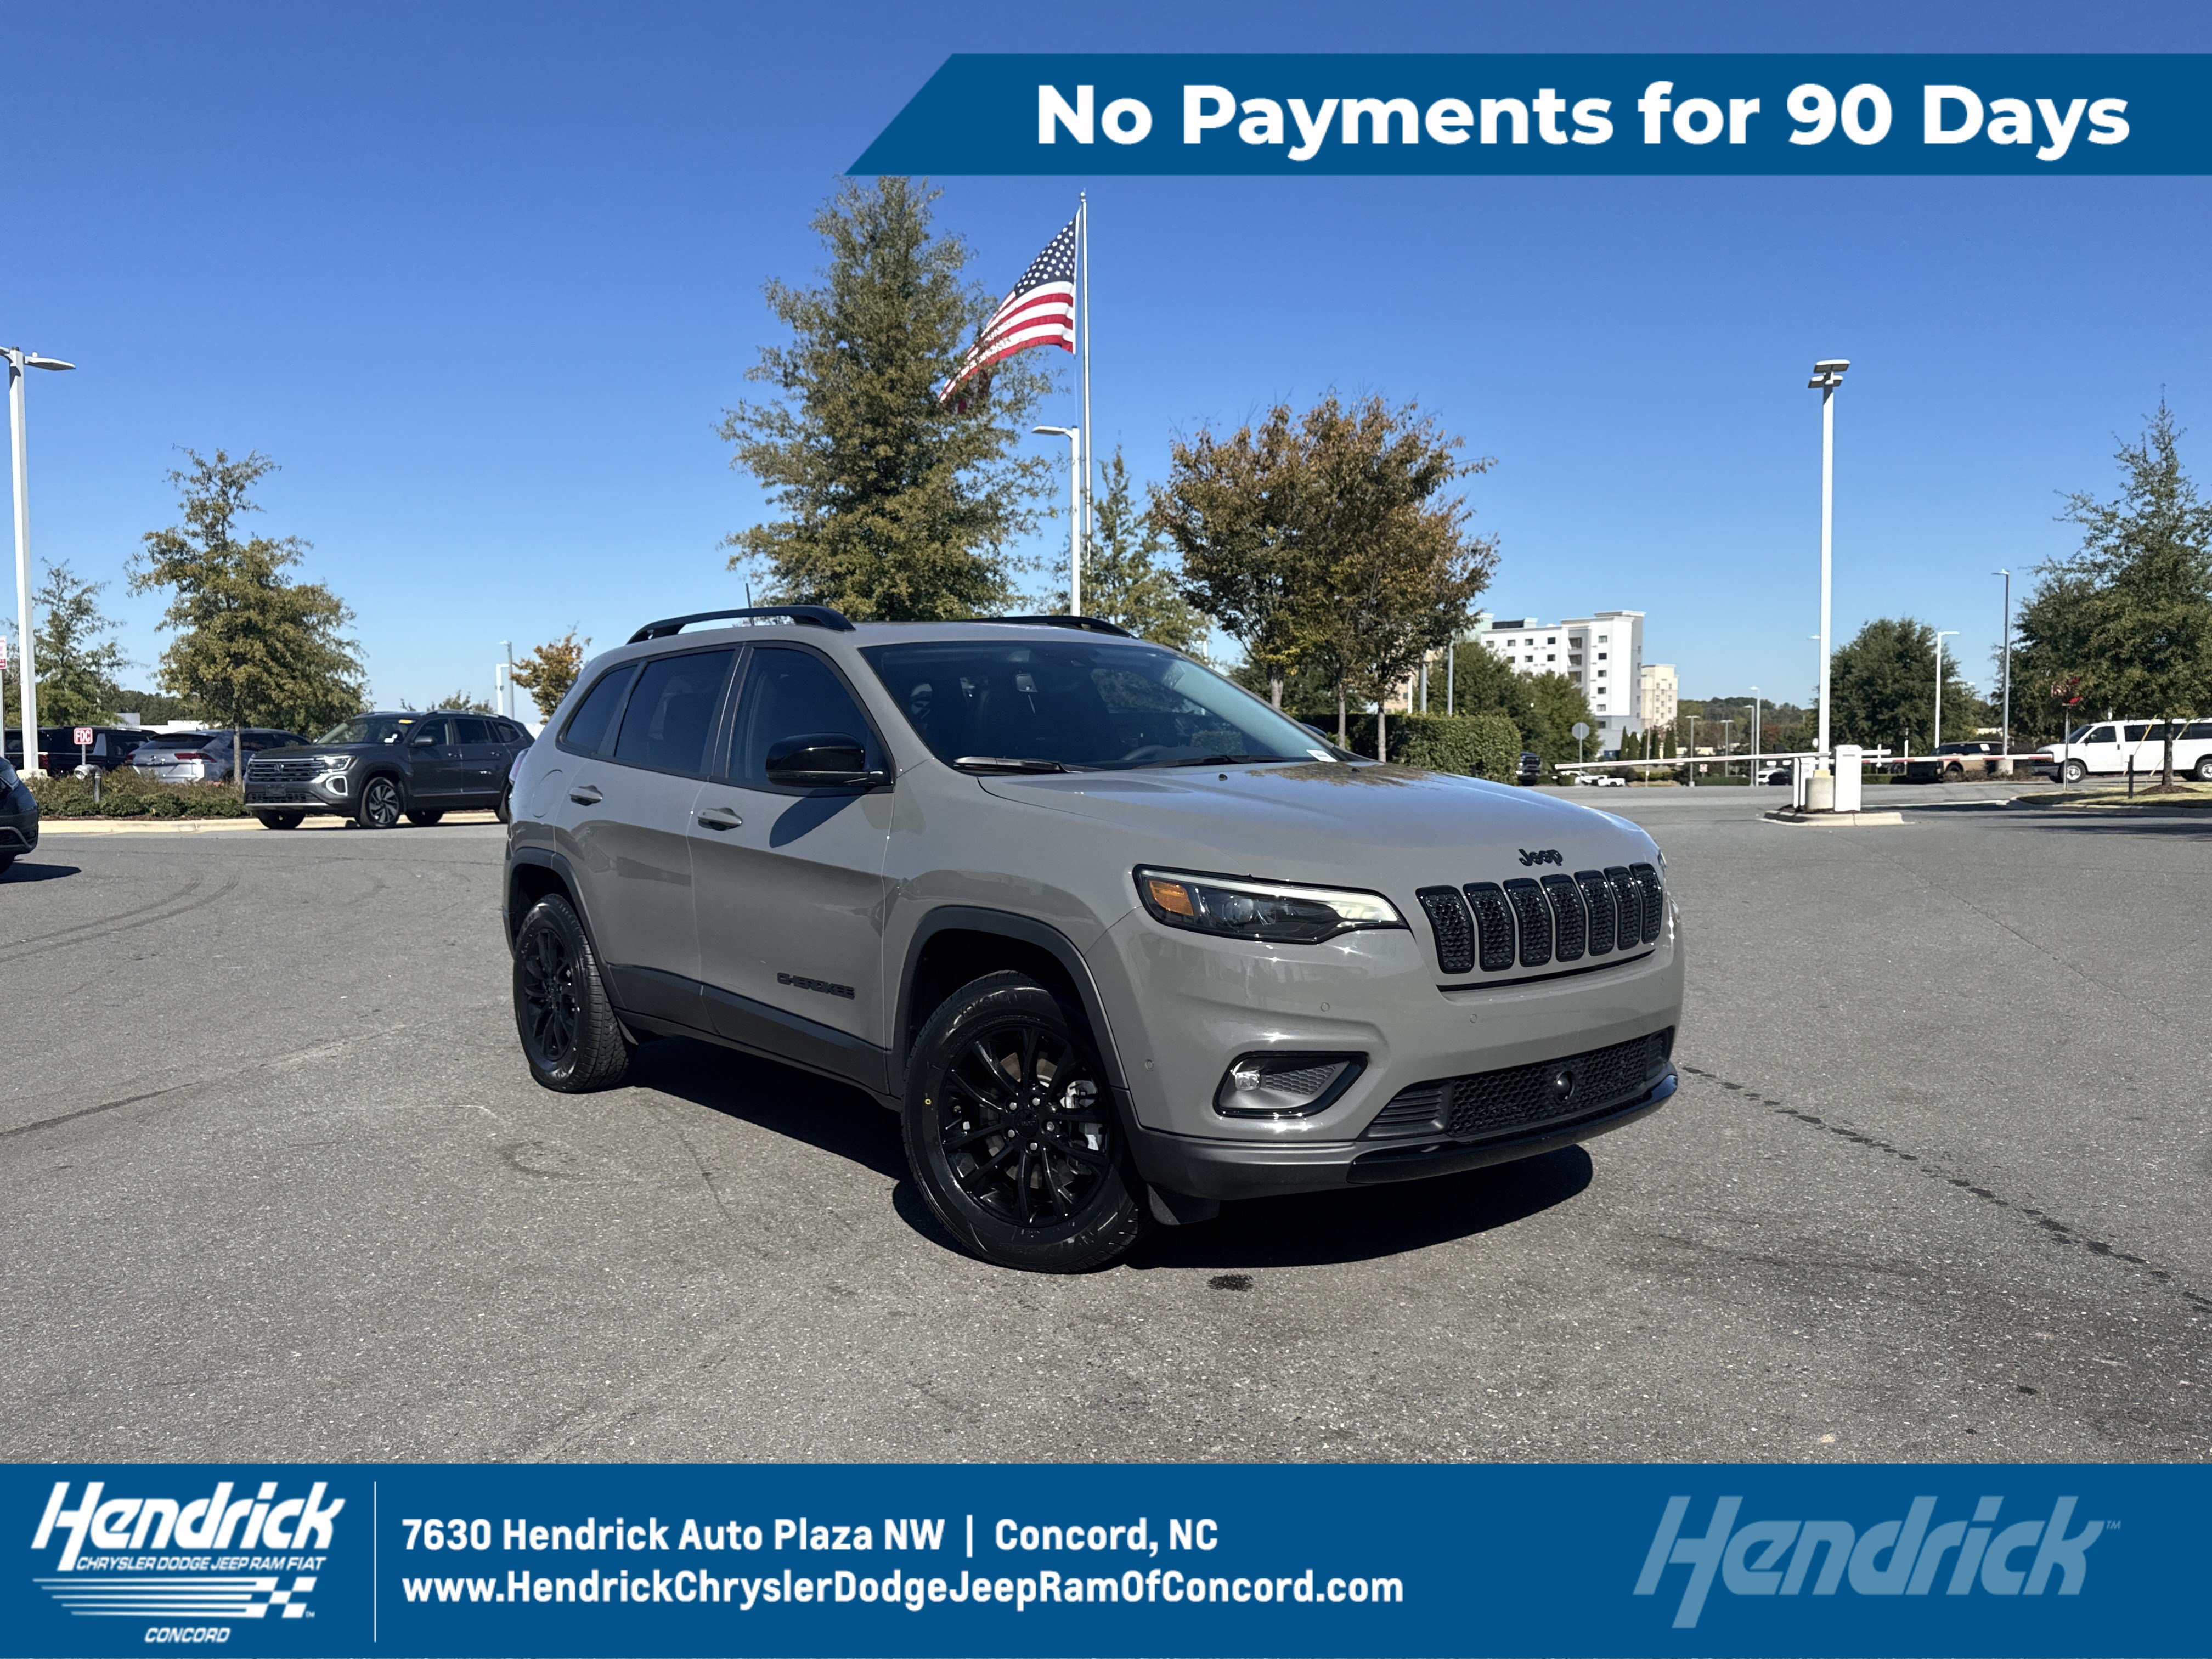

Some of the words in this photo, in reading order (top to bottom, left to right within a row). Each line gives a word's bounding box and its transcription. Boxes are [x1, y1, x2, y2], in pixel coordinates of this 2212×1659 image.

[76, 730, 91, 742] FDC
[1518, 849, 1563, 866] Jeep
[777, 973, 855, 1000] CHEROKEE
